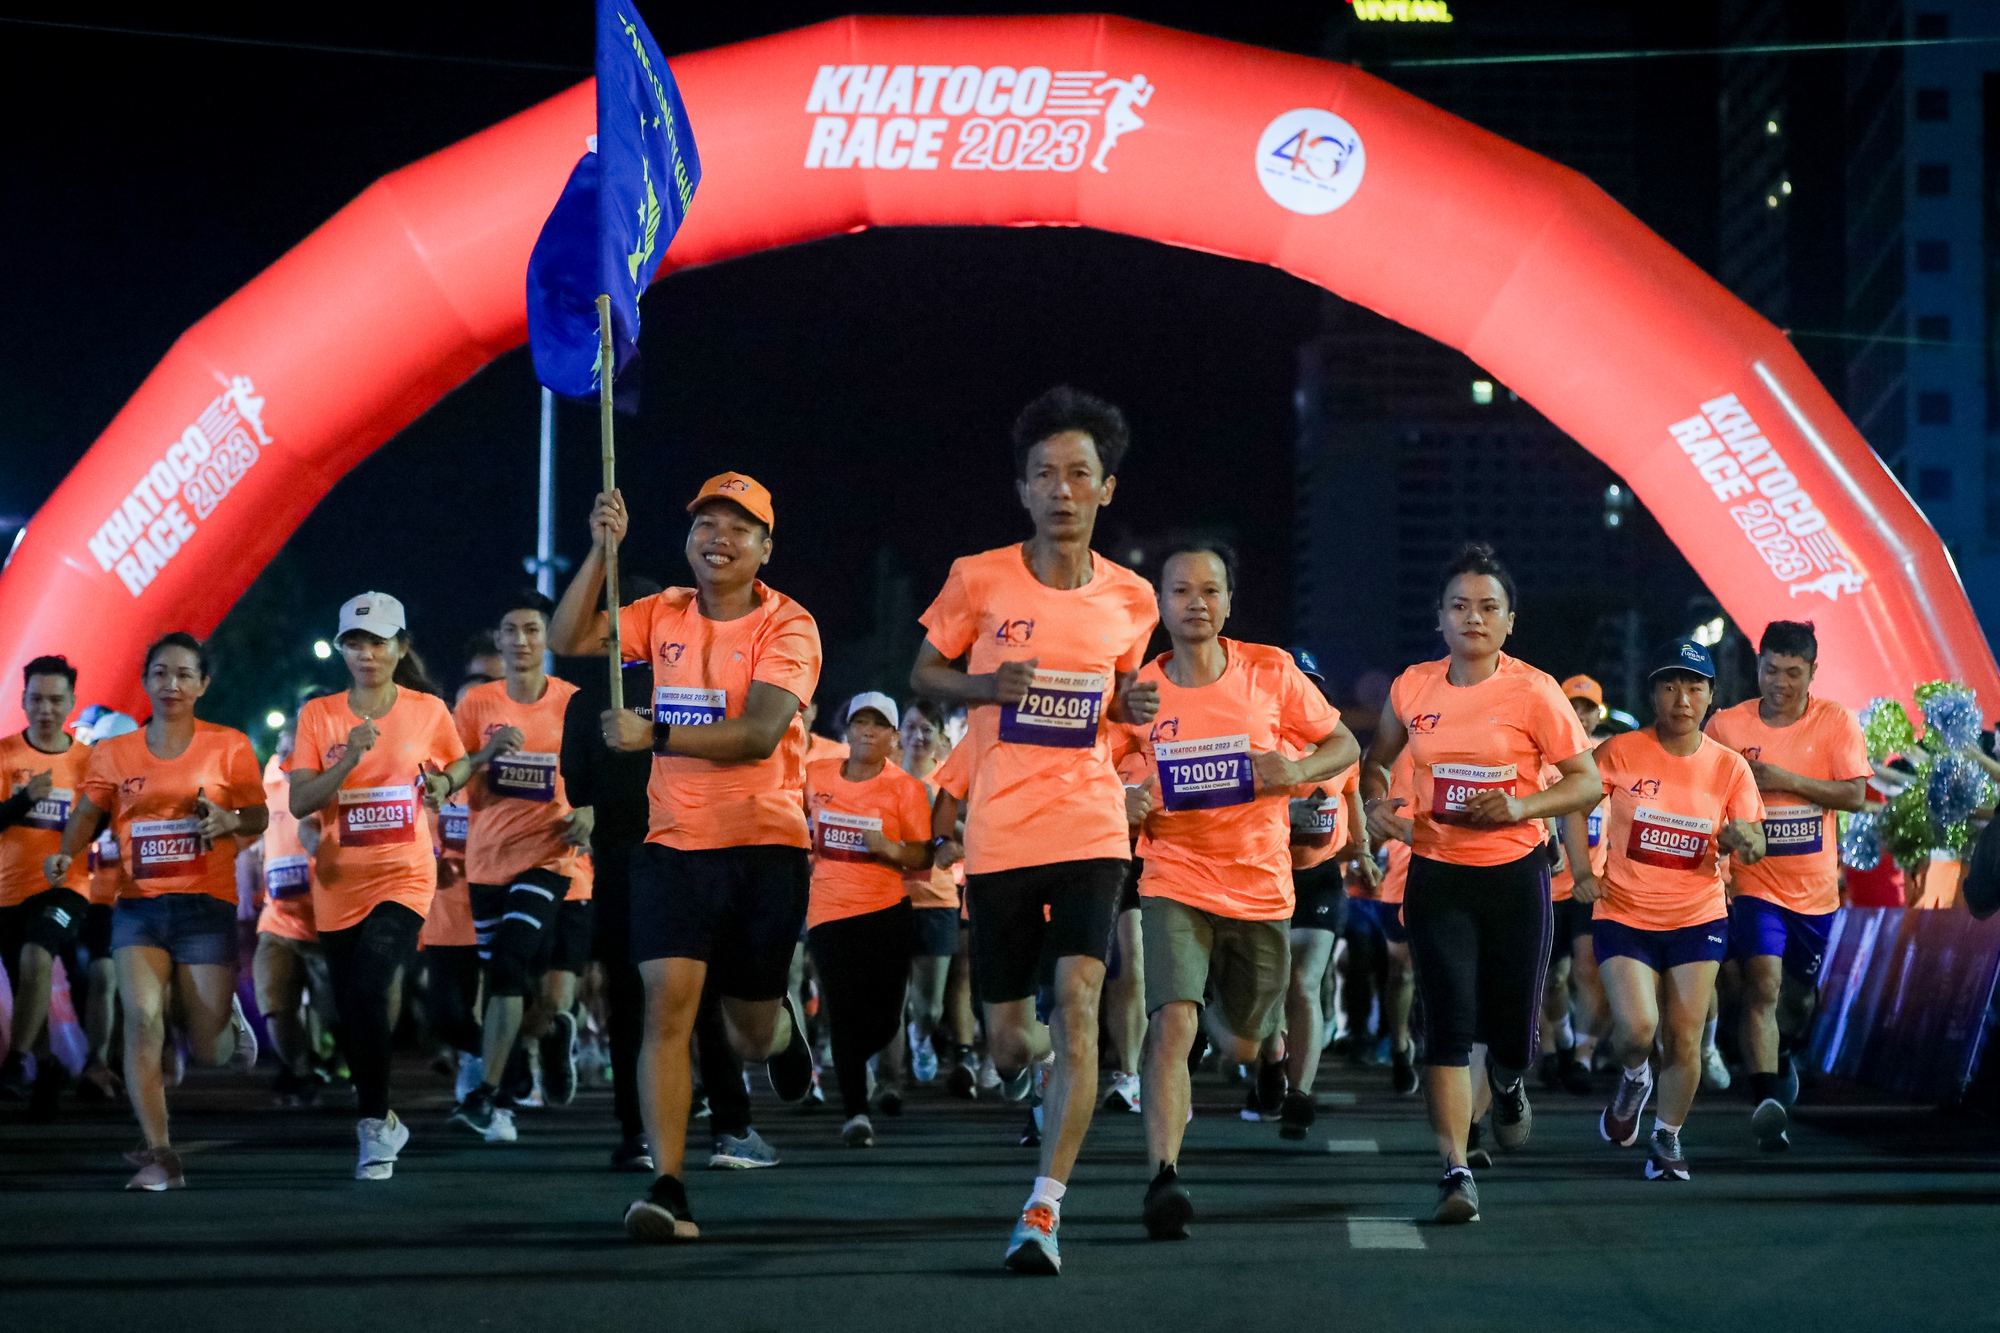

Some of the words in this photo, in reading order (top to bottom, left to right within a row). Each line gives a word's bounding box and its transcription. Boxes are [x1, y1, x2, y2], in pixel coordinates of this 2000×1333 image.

[805, 65, 1052, 117] KHATOCO
[804, 116, 950, 170] RACE
[951, 118, 1091, 171] 2023
[1700, 392, 1827, 537] KHATOCO
[87, 423, 212, 573] KHATOCO
[1667, 413, 1755, 503] RACE
[1729, 499, 1813, 582] 2023
[115, 500, 197, 598] RACE
[183, 427, 260, 520] 2023
[1170, 745, 1197, 754] KHATOCO
[1198, 743, 1213, 751] RACE
[1215, 741, 1231, 750] 2023
[1169, 759, 1239, 784] 790097
[1448, 768, 1472, 776] KHATOCO
[1472, 770, 1486, 778] RACE
[347, 804, 404, 824] 680203
[1684, 820, 1698, 828] 2023
[824, 828, 863, 846] 68033
[1640, 827, 1700, 851] 680050
[1765, 821, 1816, 837] 790385
[140, 836, 195, 856] 680277
